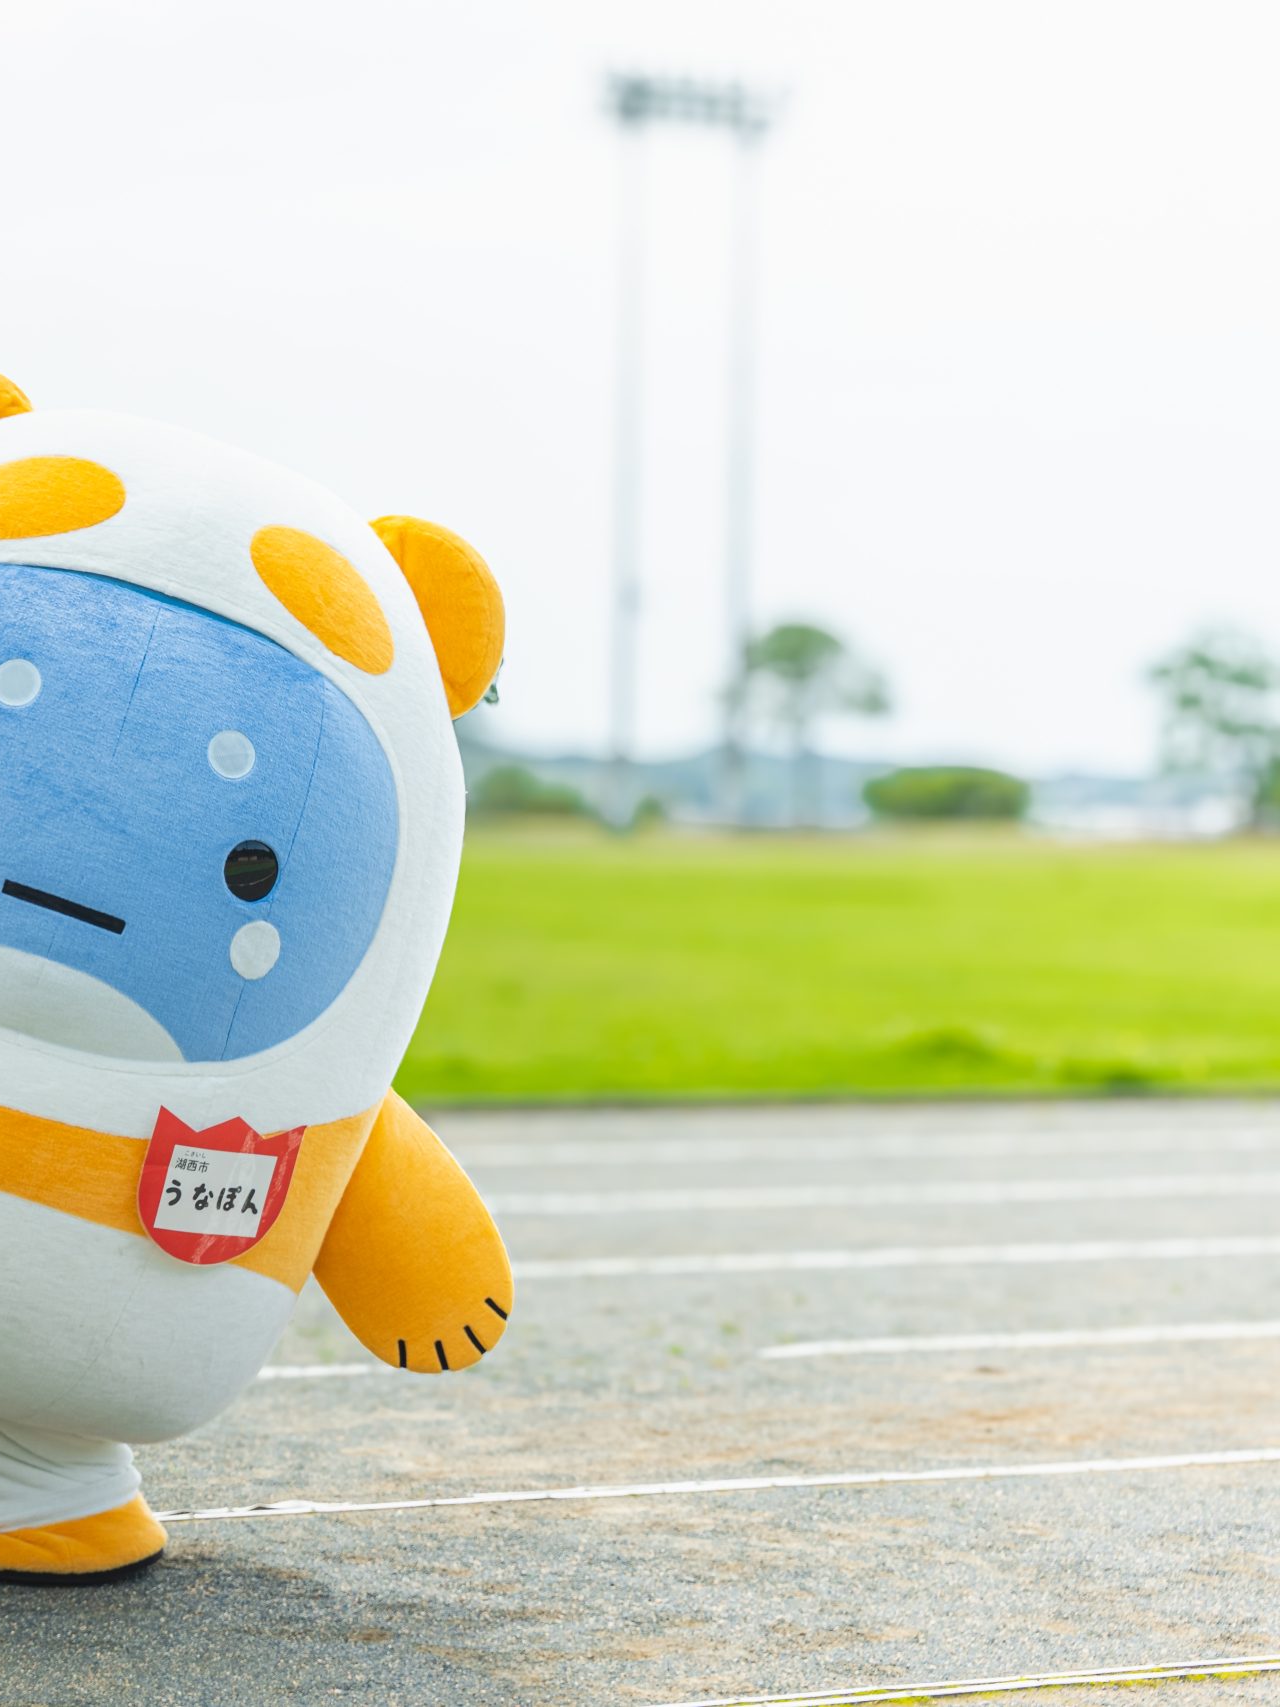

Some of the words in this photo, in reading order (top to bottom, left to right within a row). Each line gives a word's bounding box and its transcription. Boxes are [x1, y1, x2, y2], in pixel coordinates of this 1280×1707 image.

[174, 1157, 210, 1173] 湖西市
[166, 1179, 258, 1215] うなぽん
